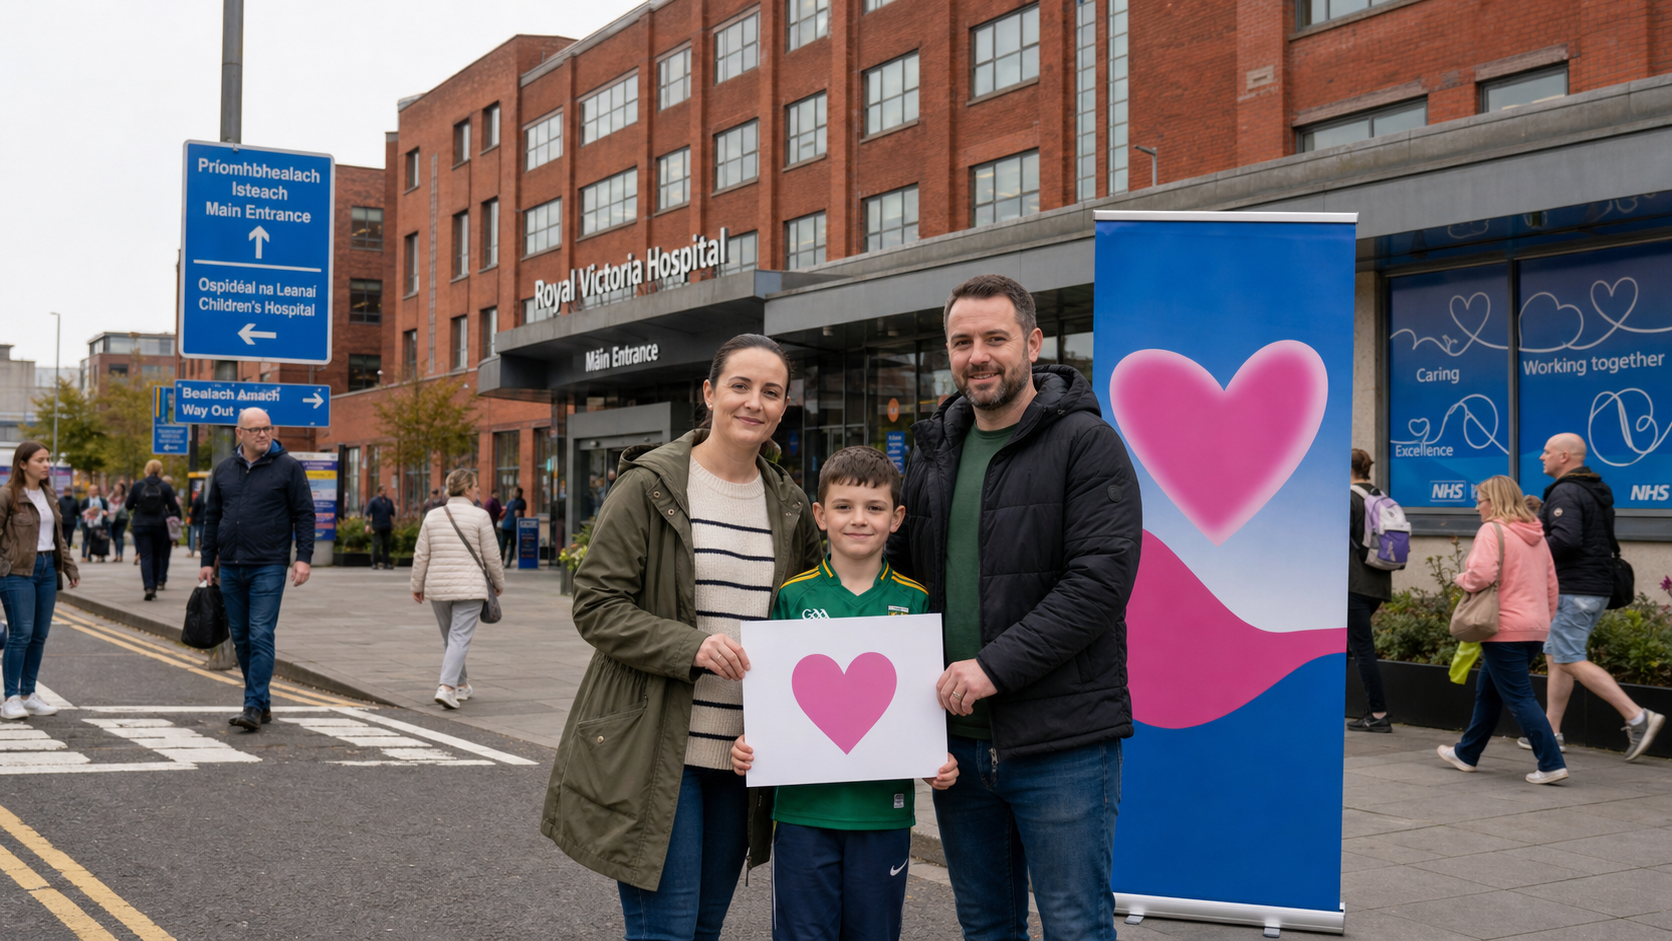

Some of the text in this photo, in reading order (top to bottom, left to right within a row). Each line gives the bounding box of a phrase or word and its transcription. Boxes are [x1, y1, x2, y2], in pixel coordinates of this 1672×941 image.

[198, 157, 320, 183] Príomhbhealach
[232, 181, 288, 201] Isteach
[206, 201, 311, 223] Main Entrance
[534, 227, 729, 314] Royal Victoria Hospital
[198, 277, 317, 298] Ospidéal na Leanaí
[198, 297, 315, 318] Children's Hospital
[612, 343, 659, 367] Entrance
[1523, 351, 1665, 376] Working together
[1416, 367, 1460, 384] Caring
[182, 387, 280, 402] Bealach Amach
[182, 404, 208, 418] Way
[211, 405, 234, 417] Out
[1395, 442, 1454, 457] Excellence
[1431, 483, 1464, 499] NHS
[1630, 484, 1670, 501] NHS
